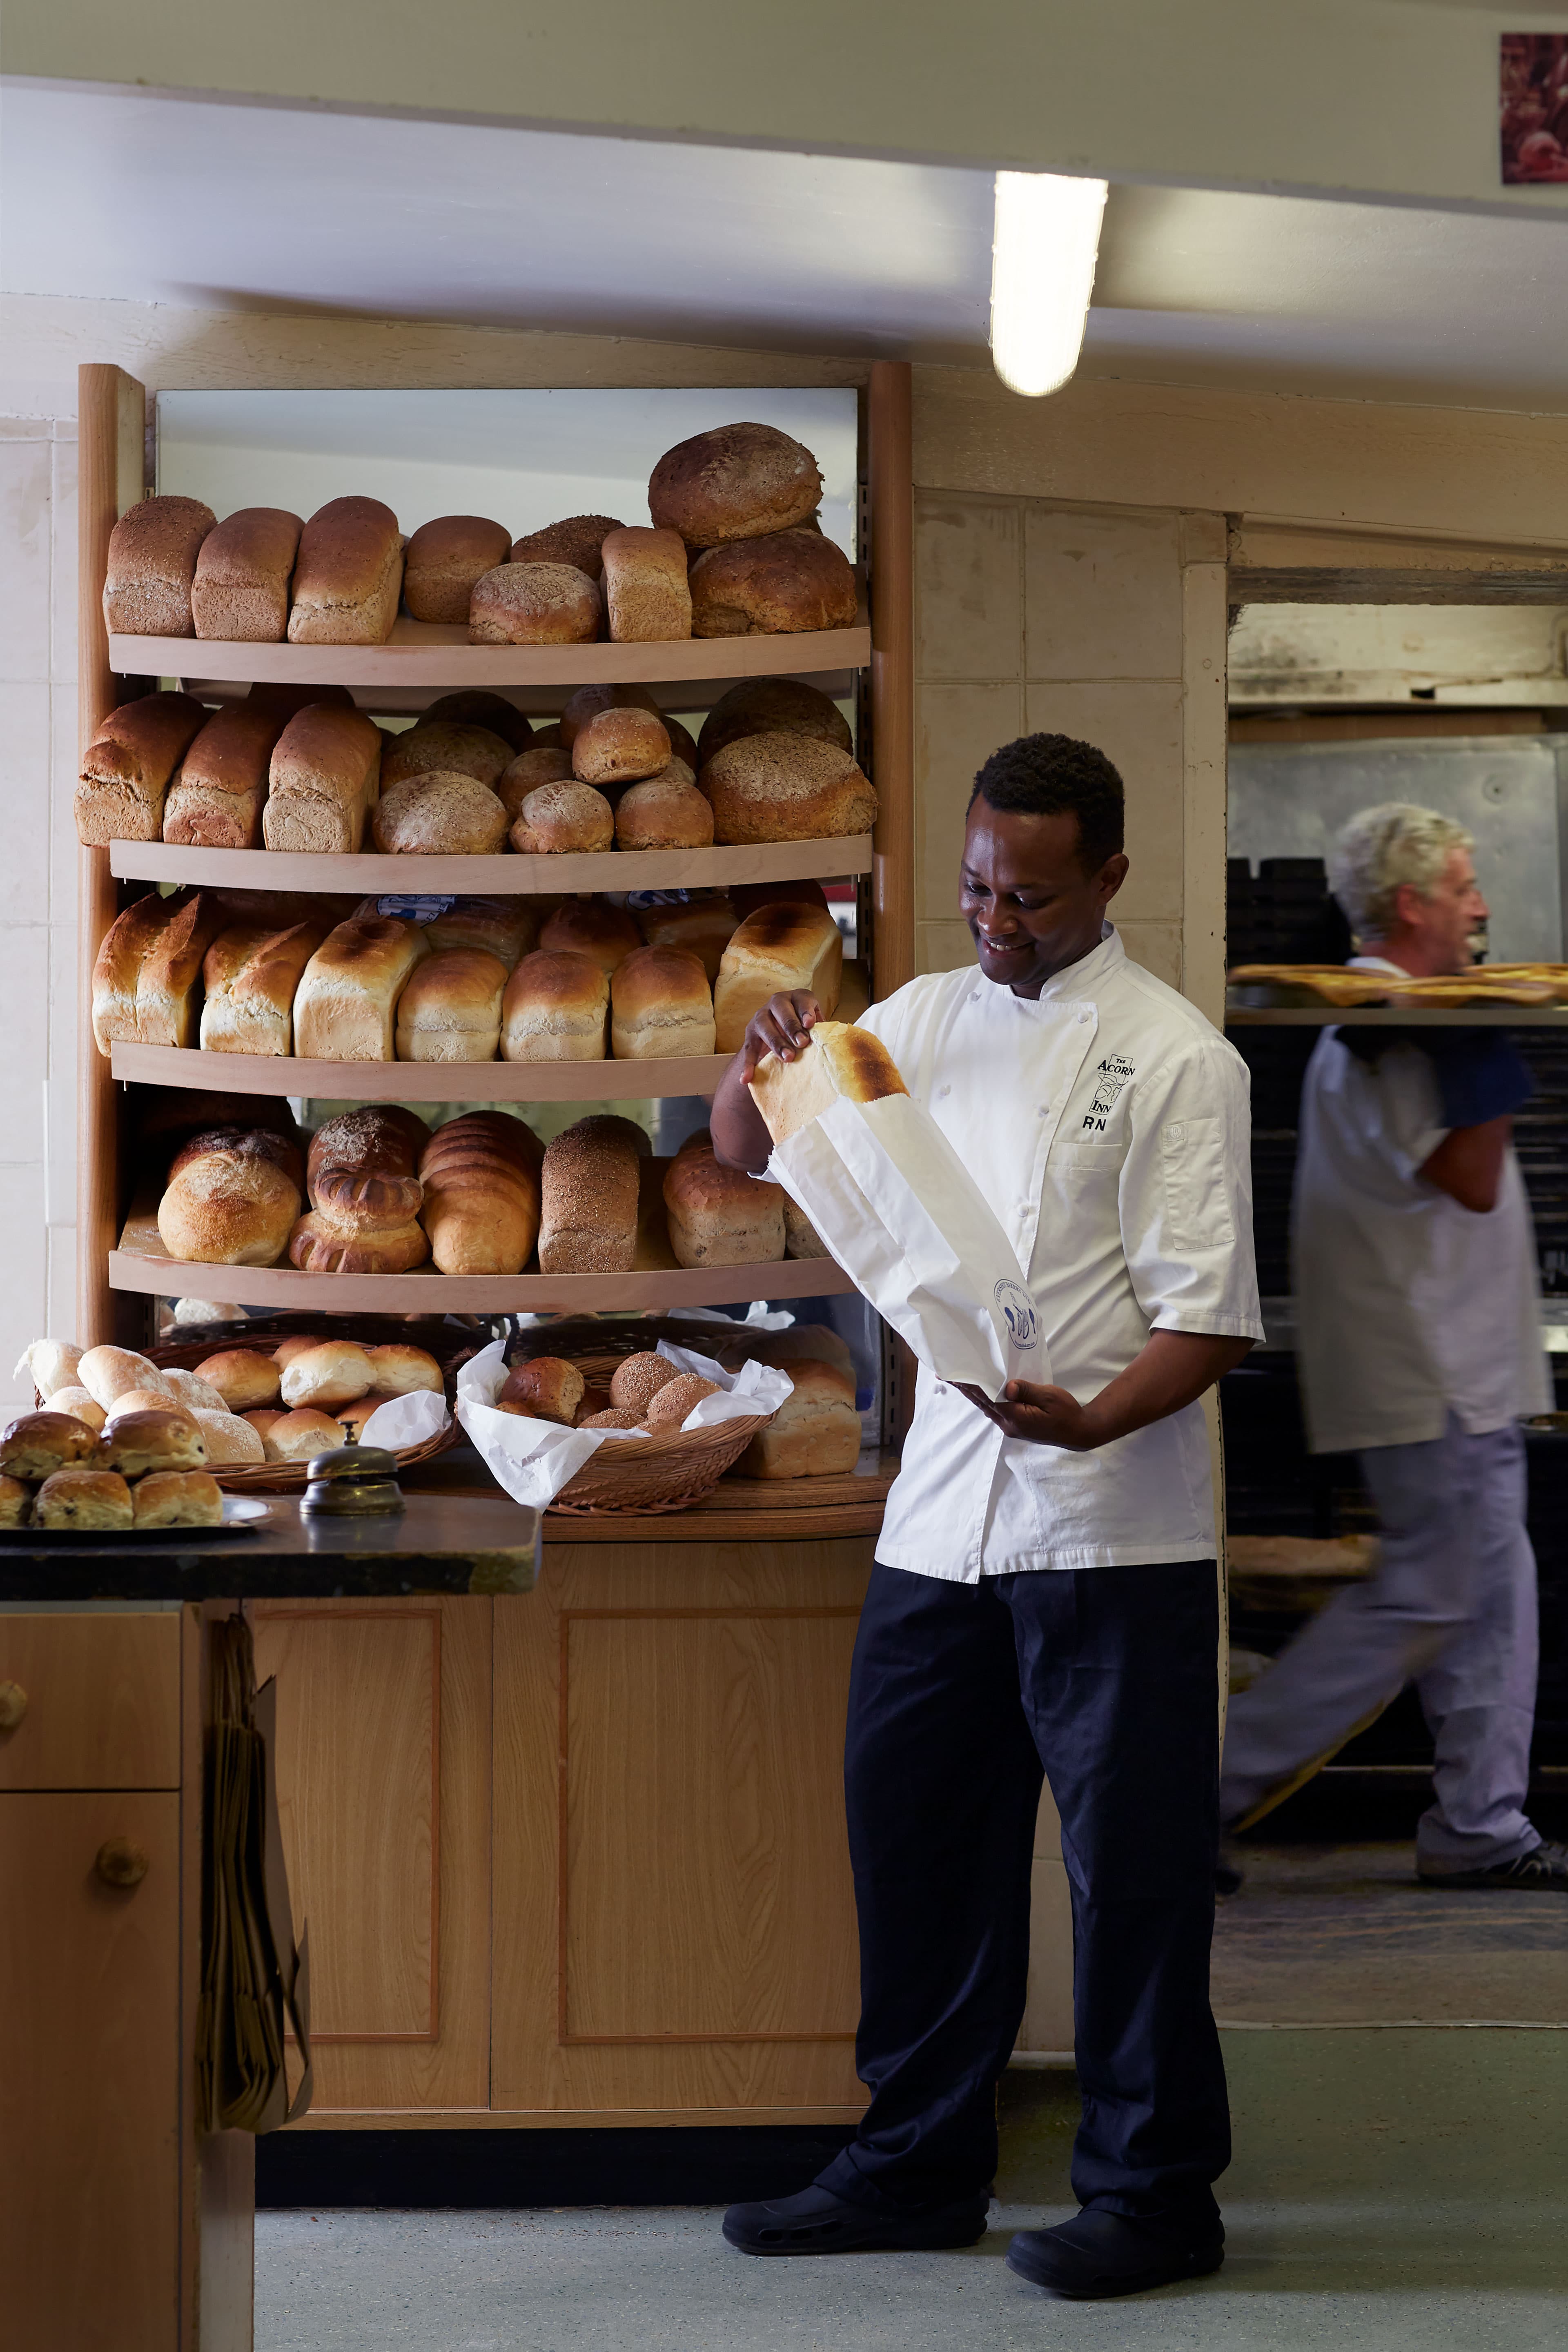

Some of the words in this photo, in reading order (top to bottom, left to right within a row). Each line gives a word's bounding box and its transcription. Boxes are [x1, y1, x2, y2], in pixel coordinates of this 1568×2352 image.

[1097, 1060, 1136, 1076] ACORN
[1091, 1100, 1111, 1113] INN
[1082, 1116, 1106, 1131] RN
